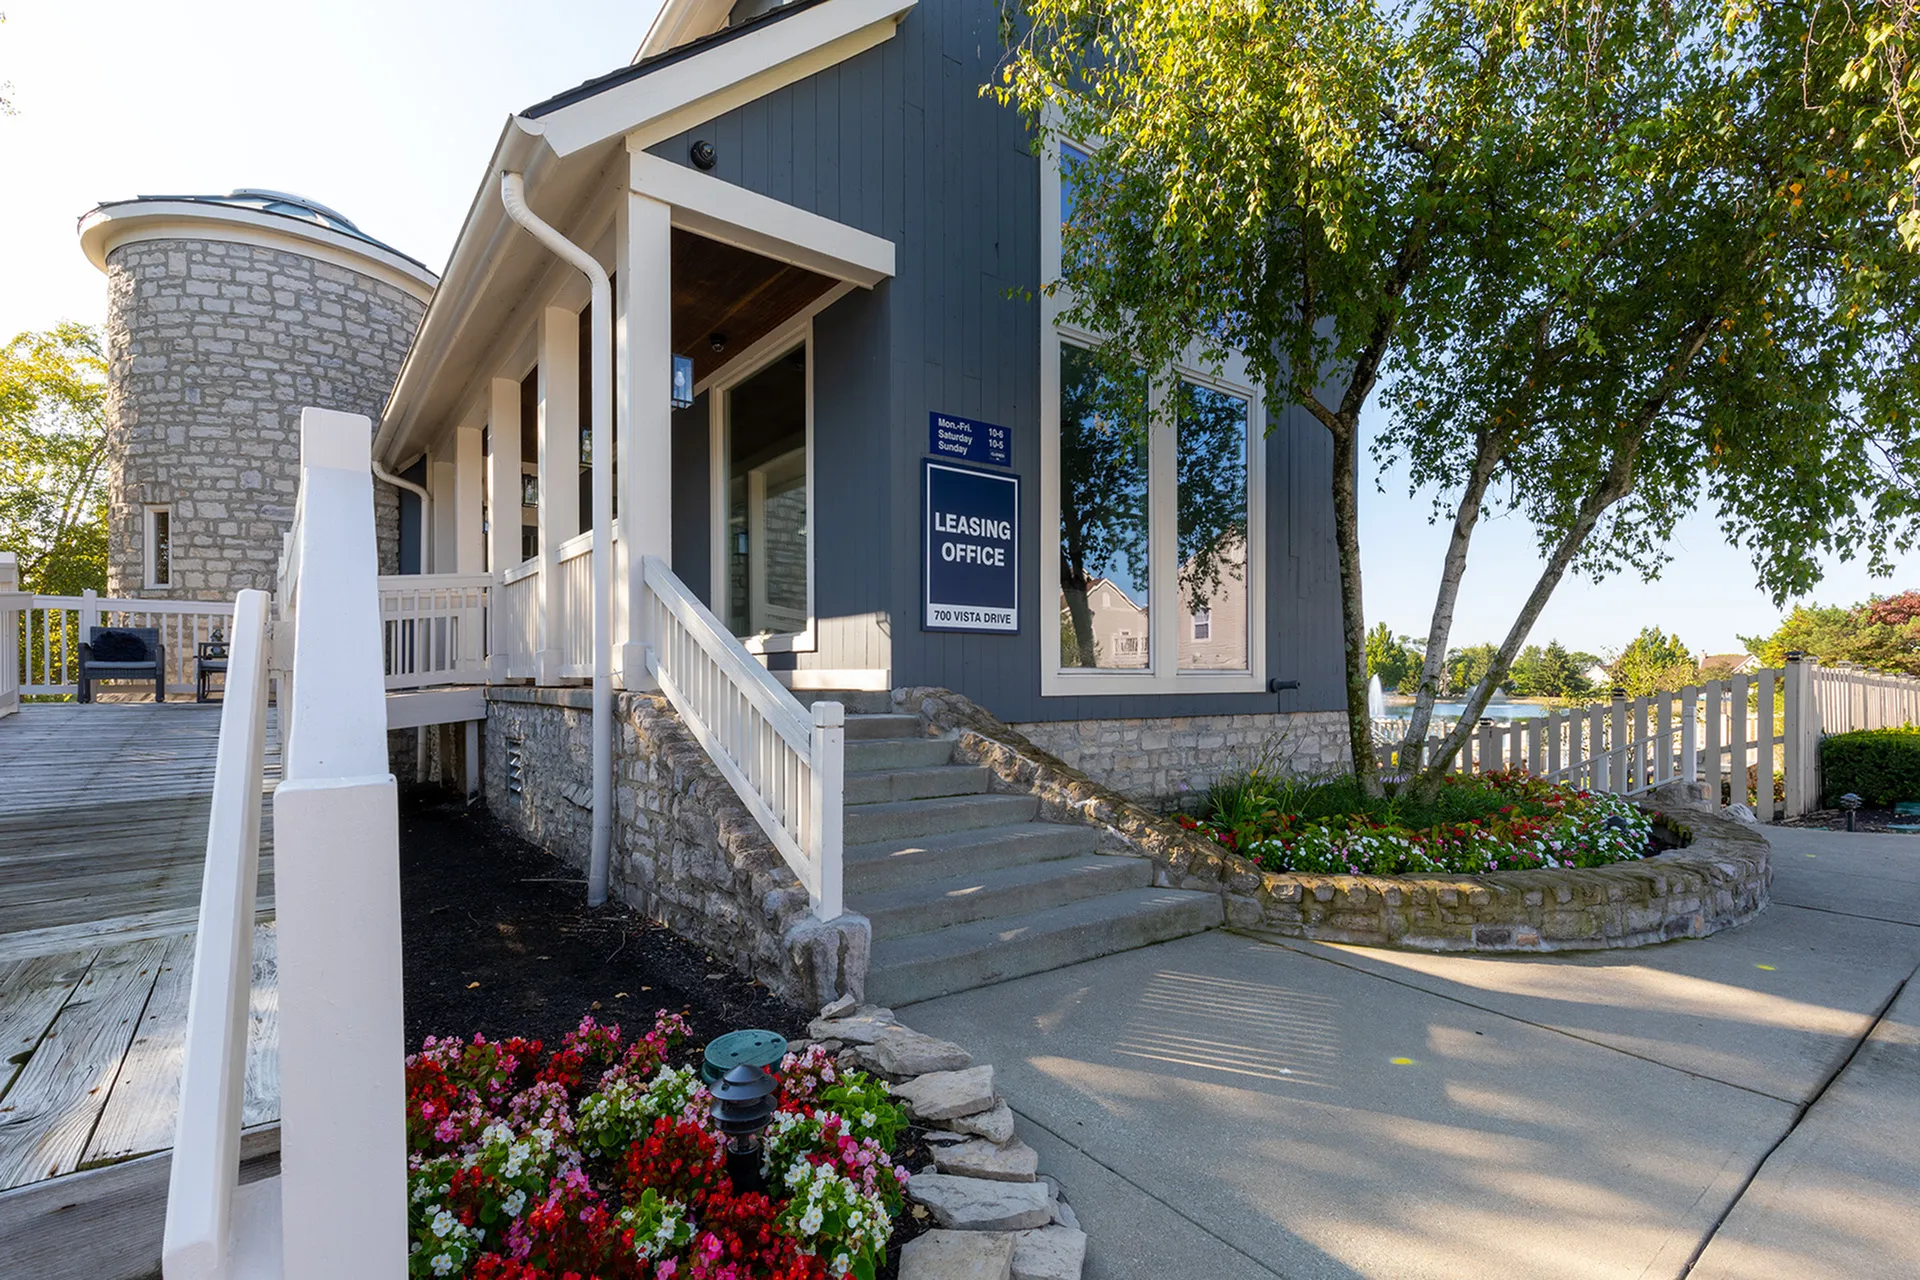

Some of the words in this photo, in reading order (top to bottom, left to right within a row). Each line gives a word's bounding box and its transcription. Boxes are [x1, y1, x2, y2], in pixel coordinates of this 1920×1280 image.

[938, 418, 972, 432] Mon.-Fri.
[988, 428, 1004, 439] 10-6
[938, 429, 973, 445] Saturday
[988, 439, 1004, 450] 10-5
[938, 440, 968, 455] Sunday
[935, 512, 1011, 540] LEASING
[941, 542, 1005, 567] OFFICE
[934, 610, 952, 621] 700
[953, 611, 981, 623] VISTA
[984, 613, 1011, 624] DRIVE
